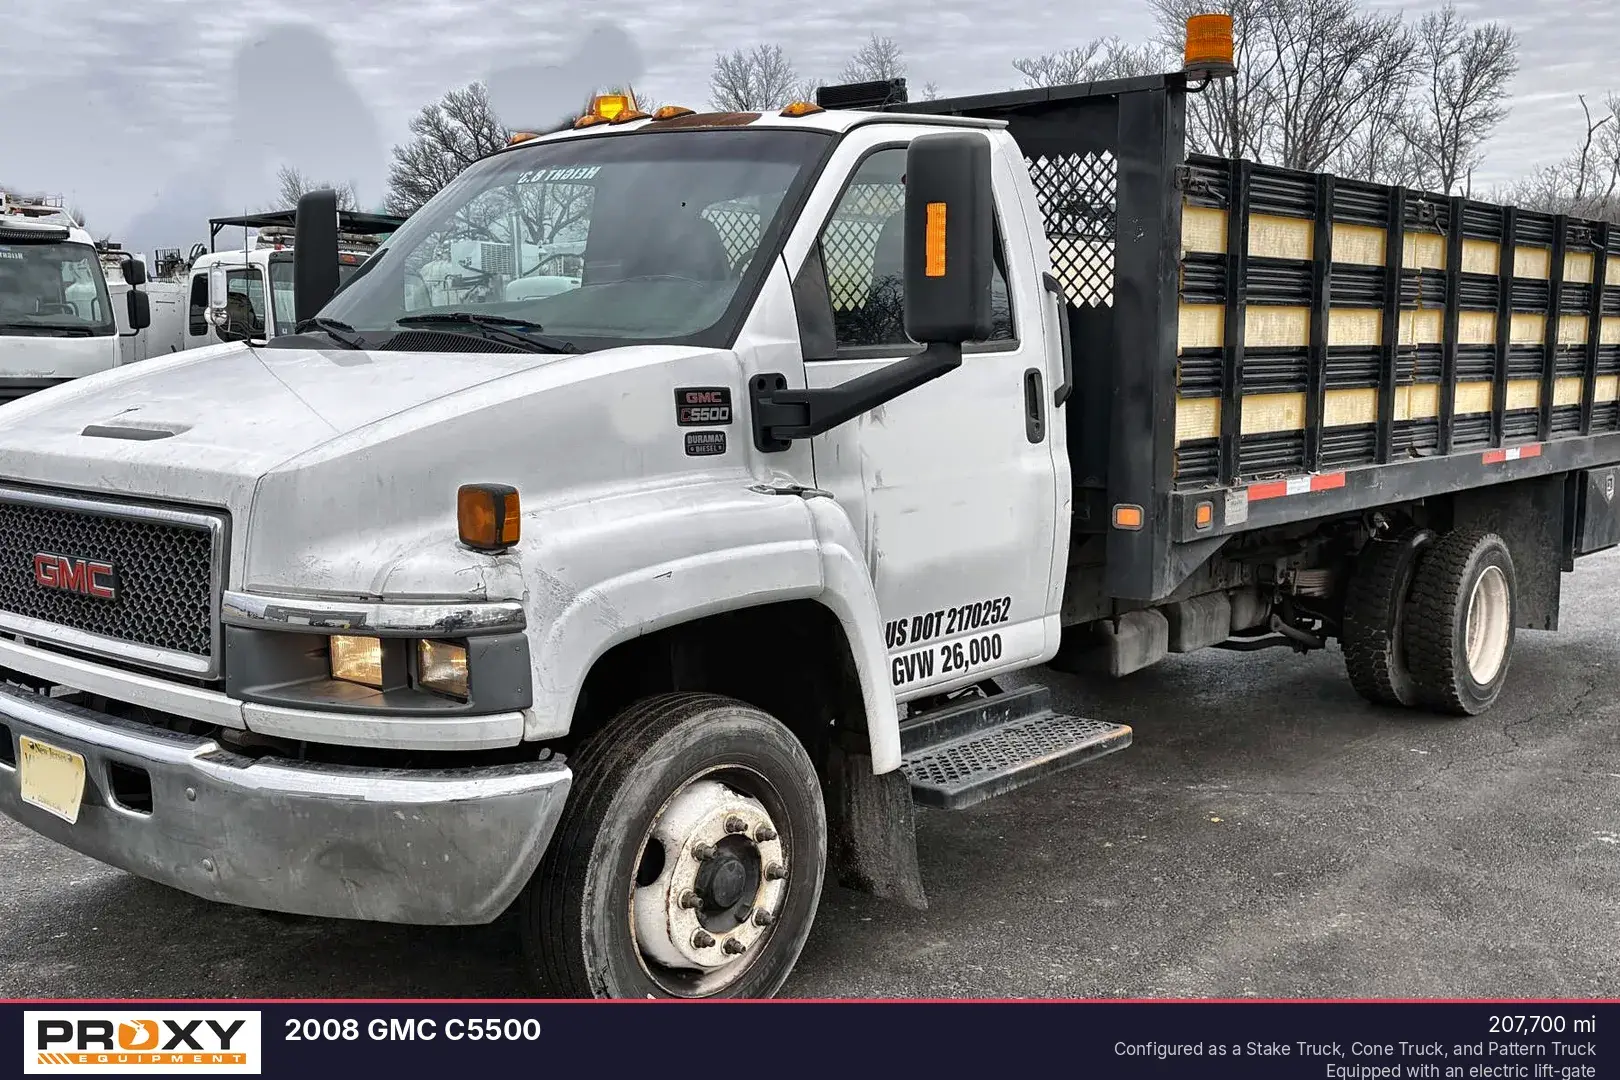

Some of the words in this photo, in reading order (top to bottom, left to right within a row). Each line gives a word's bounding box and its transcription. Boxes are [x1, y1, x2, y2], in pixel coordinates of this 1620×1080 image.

[686, 392, 722, 403] GMC
[681, 407, 730, 422] C5500
[687, 434, 724, 444] DURAMAX
[33, 552, 115, 598] GMC
[885, 618, 908, 649] US
[910, 610, 945, 643] DOT
[945, 596, 1012, 635] 2170252
[892, 648, 934, 686] GVW
[940, 633, 1002, 673] 26,000
